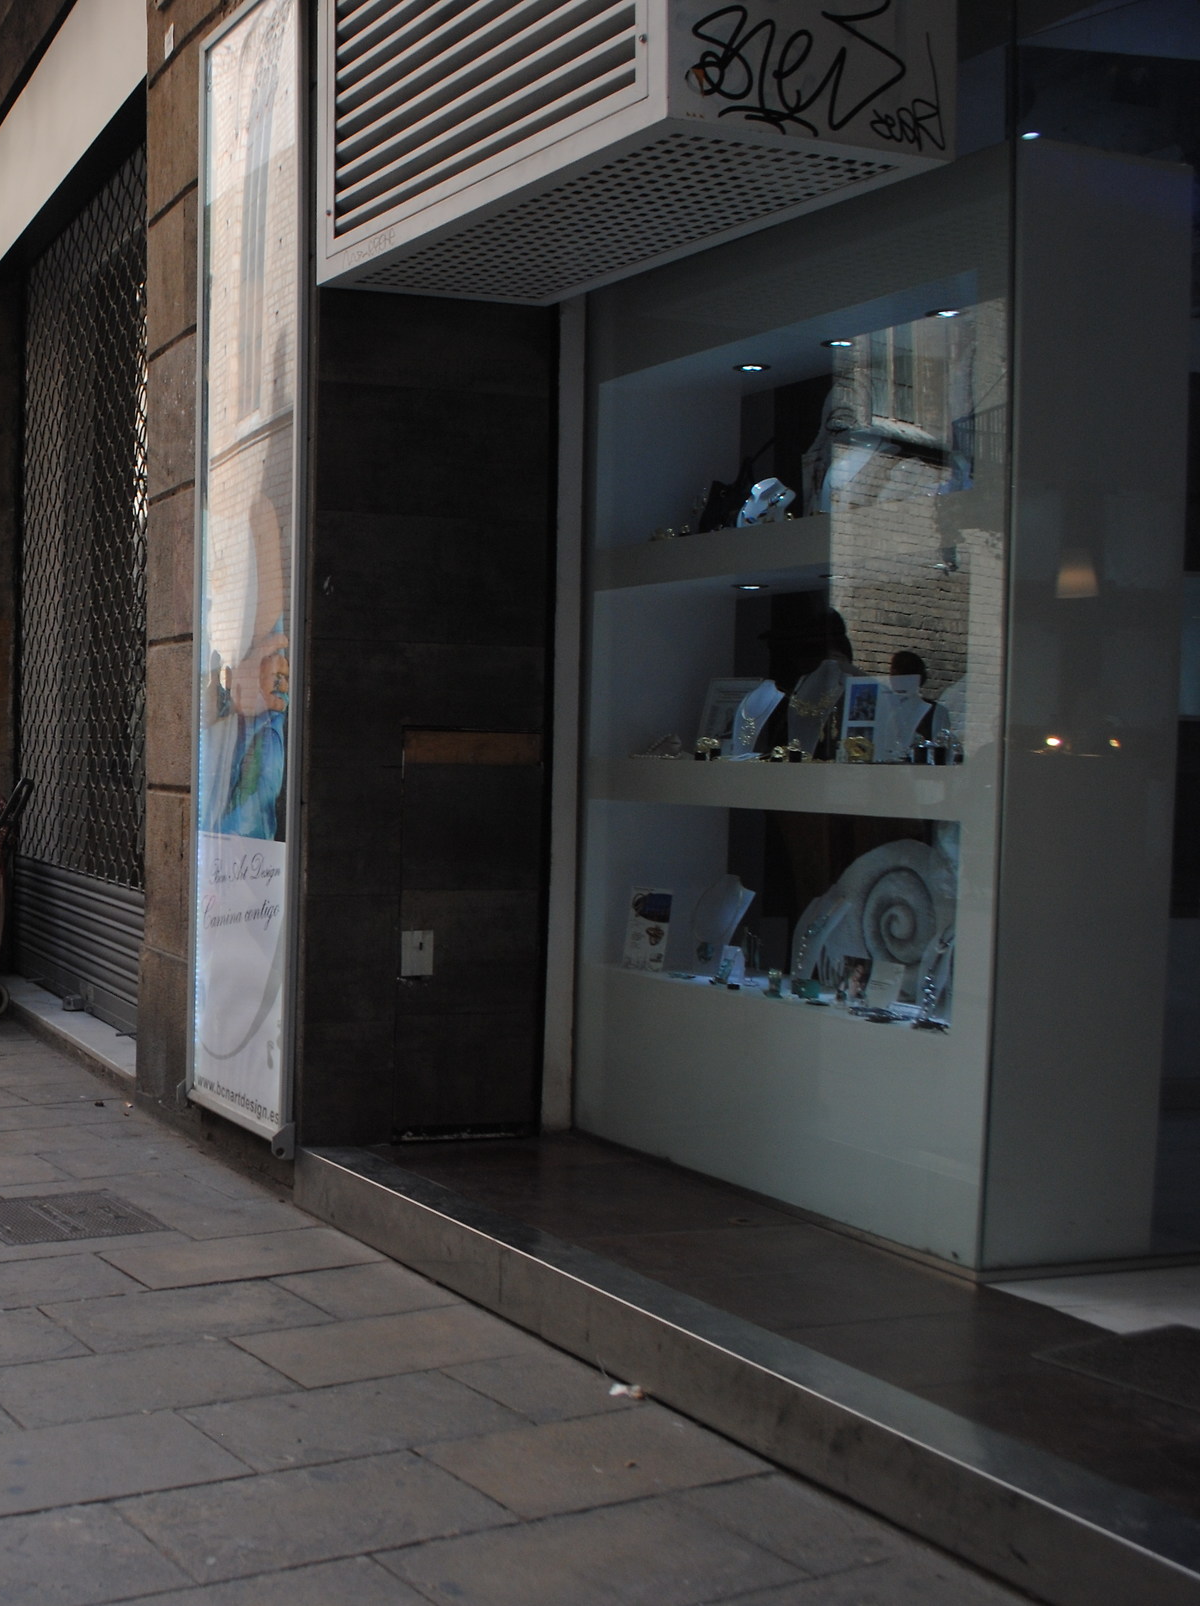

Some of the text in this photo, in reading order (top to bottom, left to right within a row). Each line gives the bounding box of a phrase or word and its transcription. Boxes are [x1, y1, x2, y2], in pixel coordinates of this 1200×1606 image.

[249, 852, 281, 887] Design
[202, 894, 280, 932] Camina contigo
[197, 1075, 280, 1125] www.bcnartdesign.es
